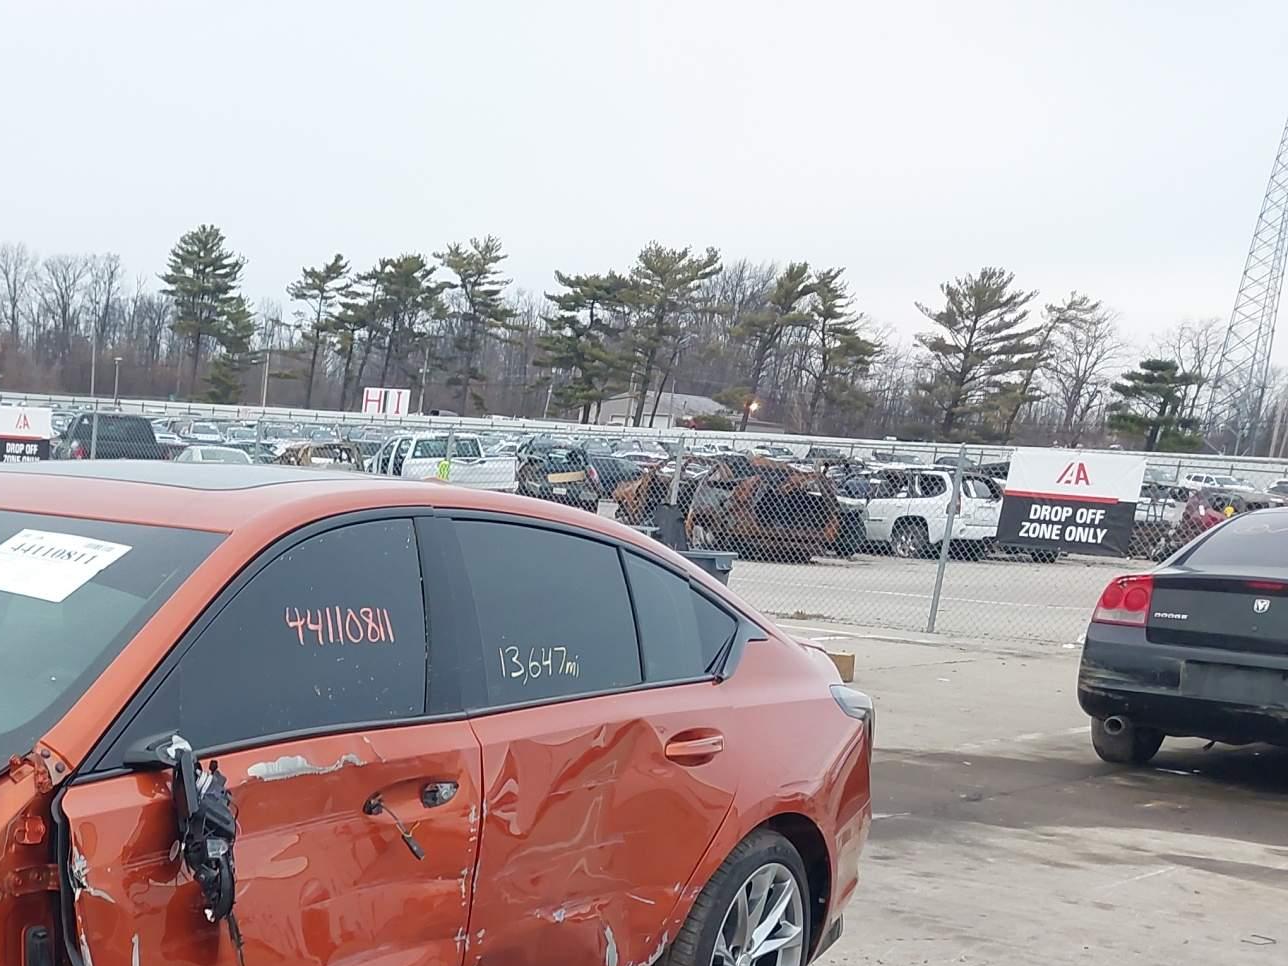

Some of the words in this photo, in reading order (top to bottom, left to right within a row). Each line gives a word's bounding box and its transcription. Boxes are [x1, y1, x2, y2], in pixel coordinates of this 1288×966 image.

[6, 442, 24, 454] DROP
[25, 443, 39, 455] OFF
[1029, 504, 1073, 522] DROP
[1075, 508, 1106, 524] OFF
[1018, 521, 1062, 540] ZONE
[1064, 526, 1108, 544] ONLY
[285, 605, 395, 646] 44110811
